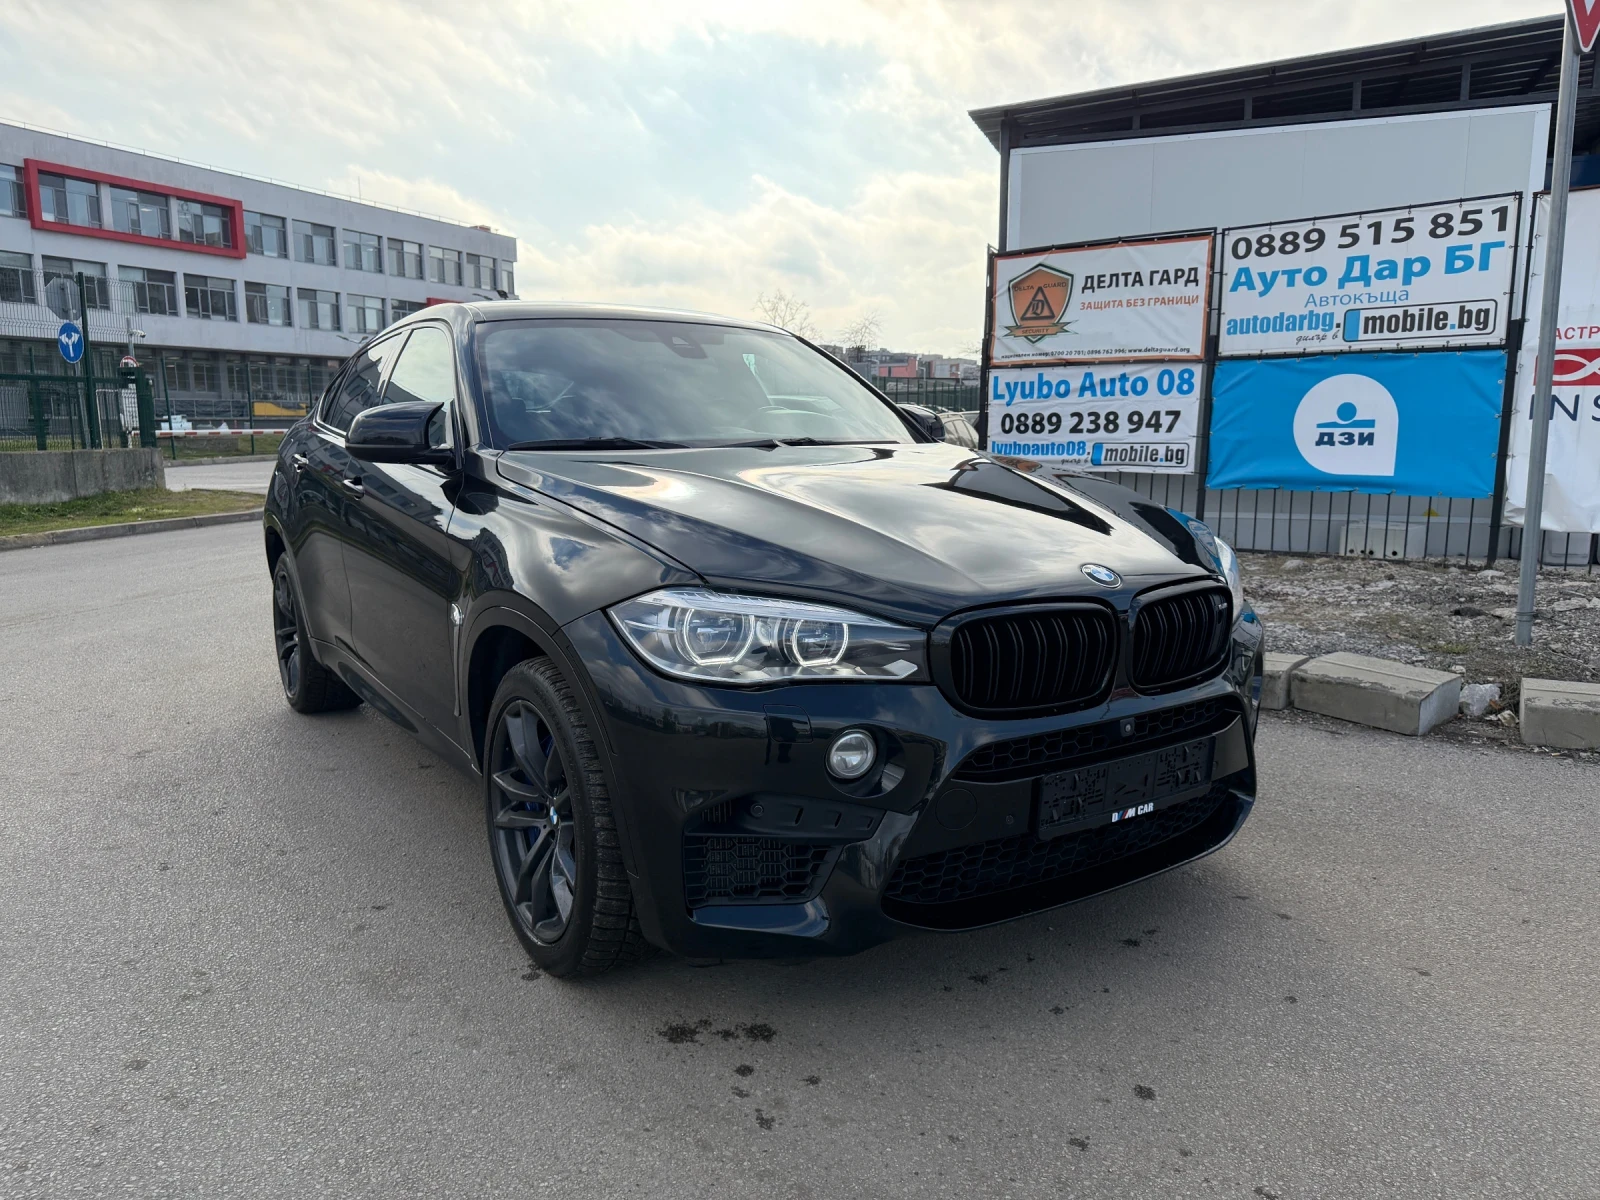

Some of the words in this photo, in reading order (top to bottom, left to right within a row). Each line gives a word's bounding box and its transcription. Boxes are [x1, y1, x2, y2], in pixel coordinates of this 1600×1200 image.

[1231, 228, 1326, 260] 0889
[1337, 216, 1415, 249] 515
[1428, 205, 1509, 239] 851
[1081, 271, 1144, 294] ДЕЛТА
[1149, 266, 1199, 287] ГАРД
[1229, 266, 1328, 298] Ауто
[1337, 254, 1431, 290] Дар
[1444, 240, 1506, 275] БГ
[1042, 281, 1067, 289] GUARD
[1079, 300, 1123, 311] ЗАЩИТА
[1126, 298, 1145, 308] БЕЗ
[1147, 294, 1199, 307] ГРАНИЦИ
[1304, 289, 1409, 308] Автокъща
[1363, 304, 1490, 335] mobile.bg
[992, 373, 1070, 407] Lyubo
[1078, 372, 1149, 398] Auto
[1156, 368, 1195, 396] 08
[1001, 412, 1062, 435] 0889
[1069, 411, 1119, 434] 238
[1127, 410, 1182, 433] 947
[1104, 443, 1185, 464] mobile.bg
[1137, 802, 1154, 815] CAR
